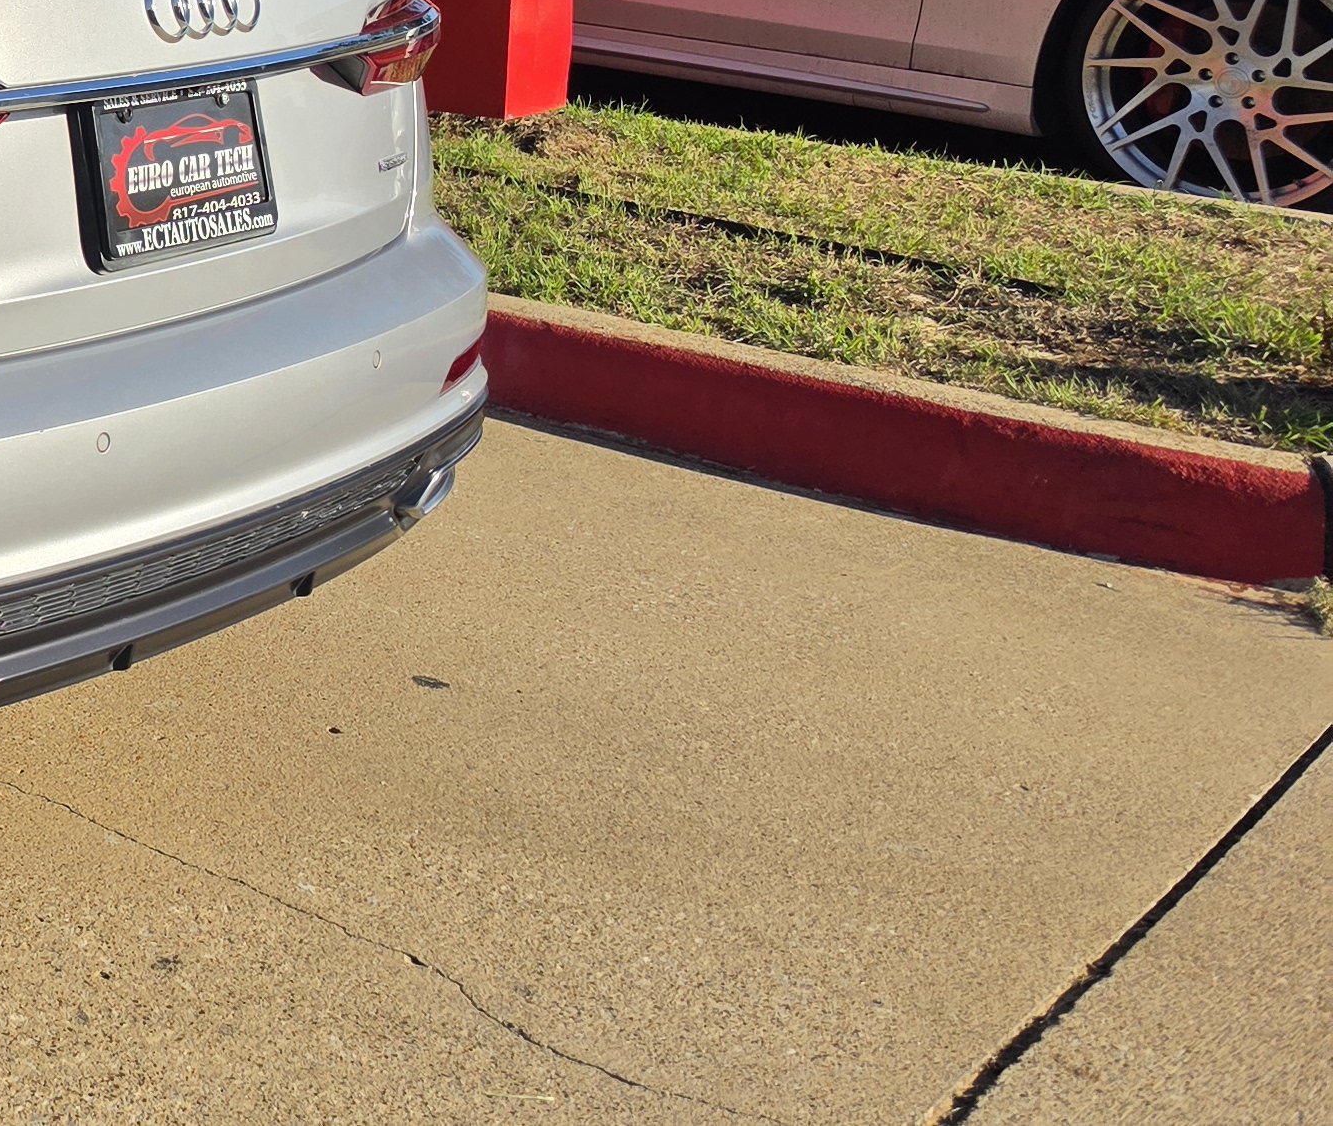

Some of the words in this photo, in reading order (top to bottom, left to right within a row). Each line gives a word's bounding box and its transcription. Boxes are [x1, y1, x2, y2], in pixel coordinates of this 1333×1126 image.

[127, 159, 174, 194] EURO
[179, 153, 212, 184] CAR
[215, 144, 255, 172] TECH
[170, 182, 211, 198] european
[212, 172, 258, 188] automotive
[172, 192, 261, 220] 817-404-4033
[116, 207, 275, 257] www.ECTAUTOSALES.com
